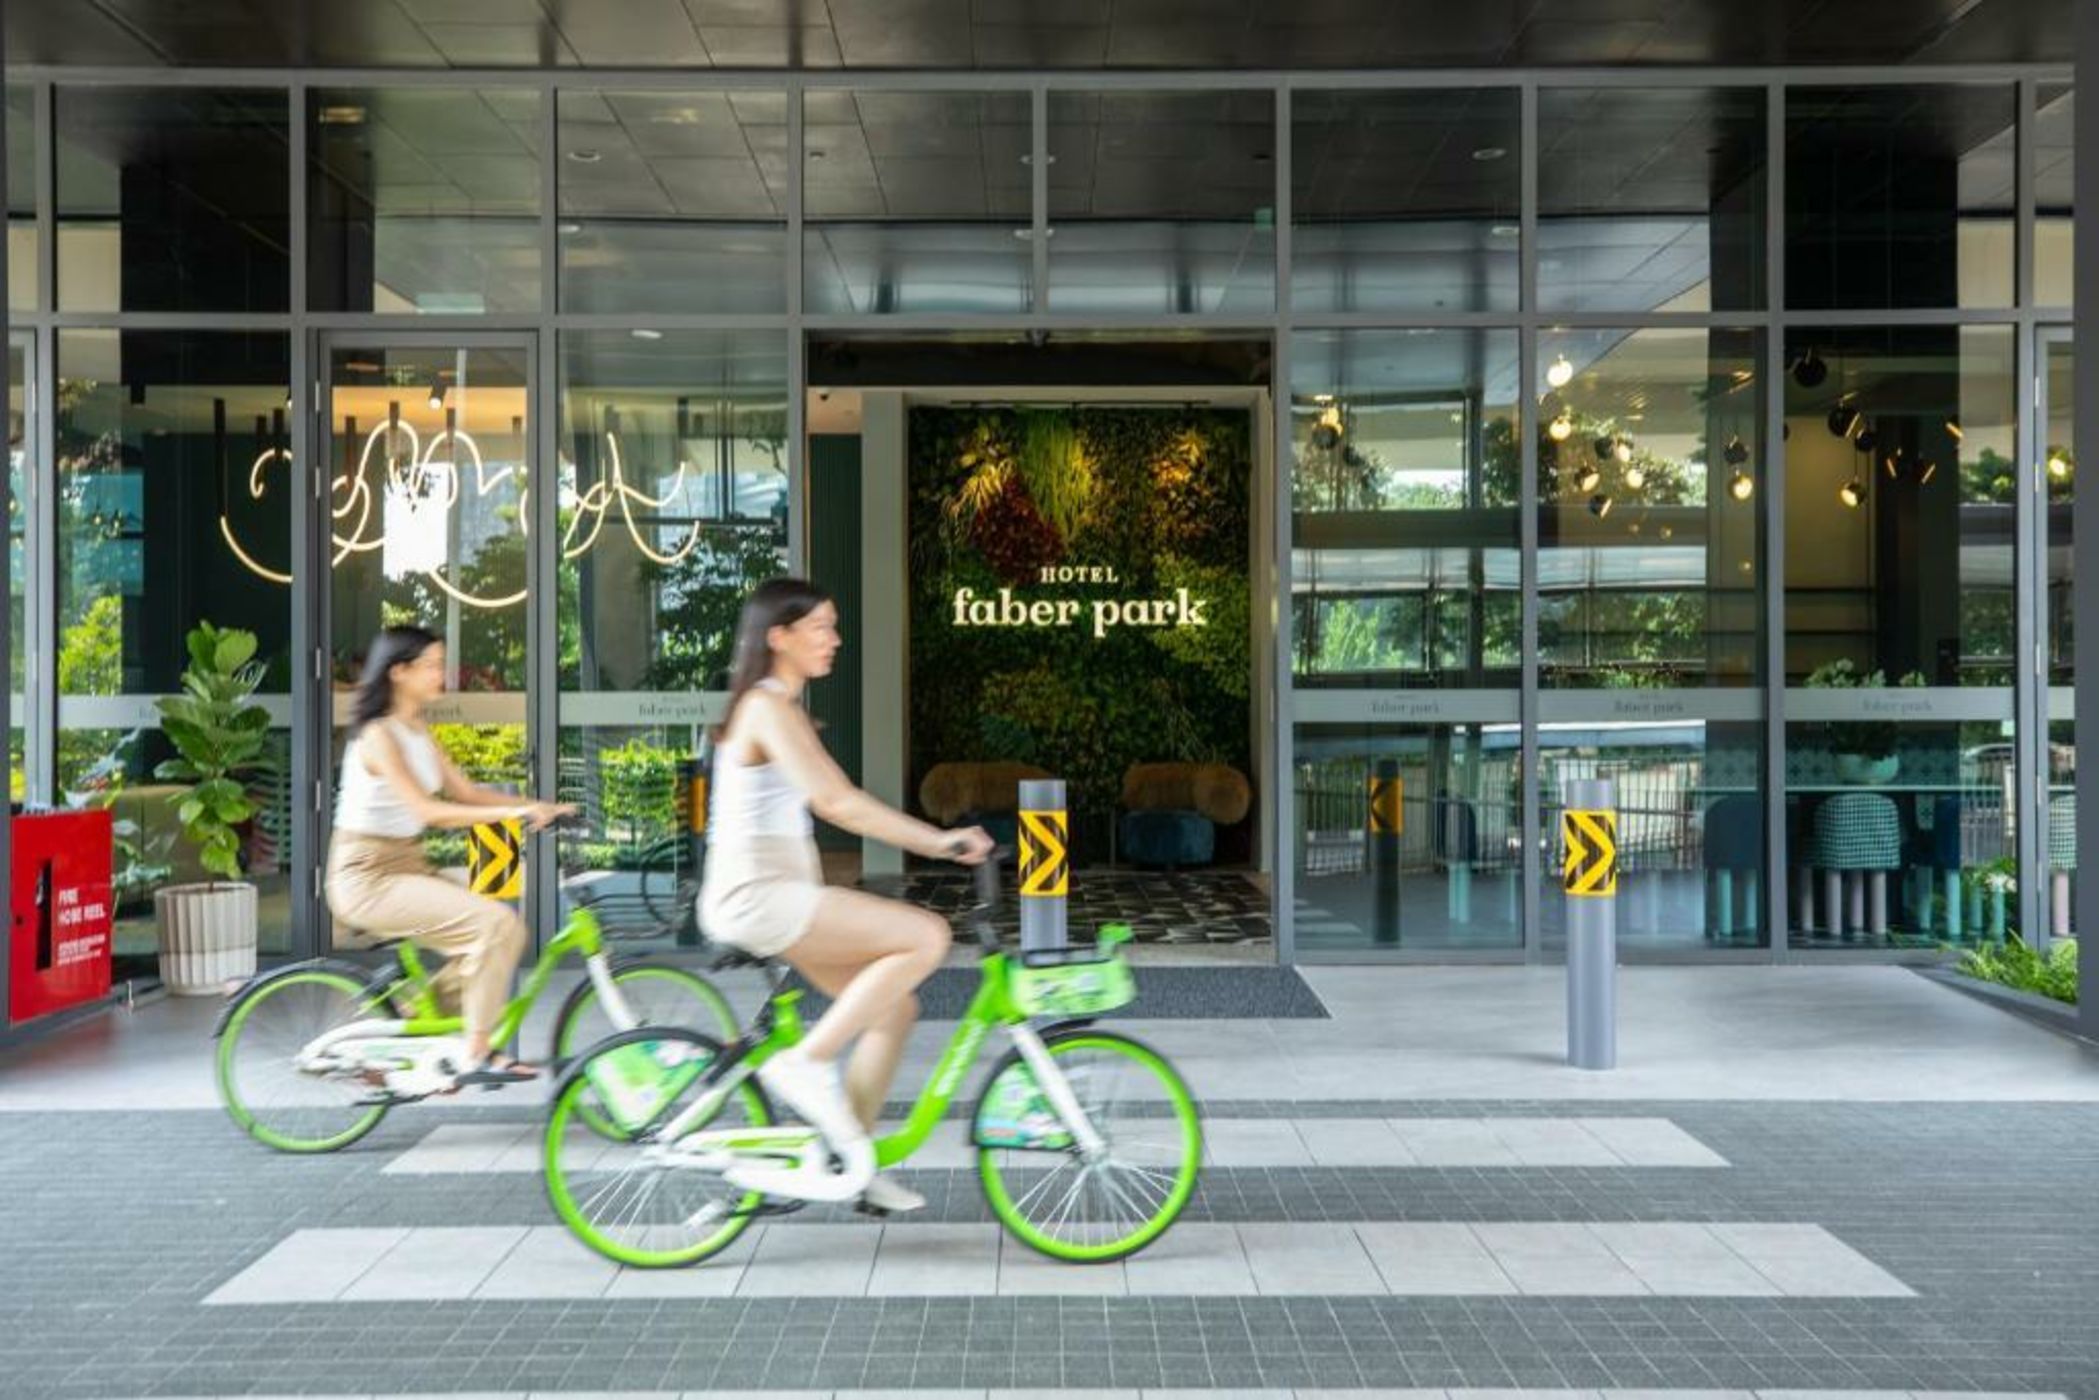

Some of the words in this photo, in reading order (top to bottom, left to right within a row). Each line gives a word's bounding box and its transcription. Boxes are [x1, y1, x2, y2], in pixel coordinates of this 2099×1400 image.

[1040, 567, 1119, 583] HOTEL
[953, 587, 1080, 627] faber
[1092, 587, 1208, 638] park
